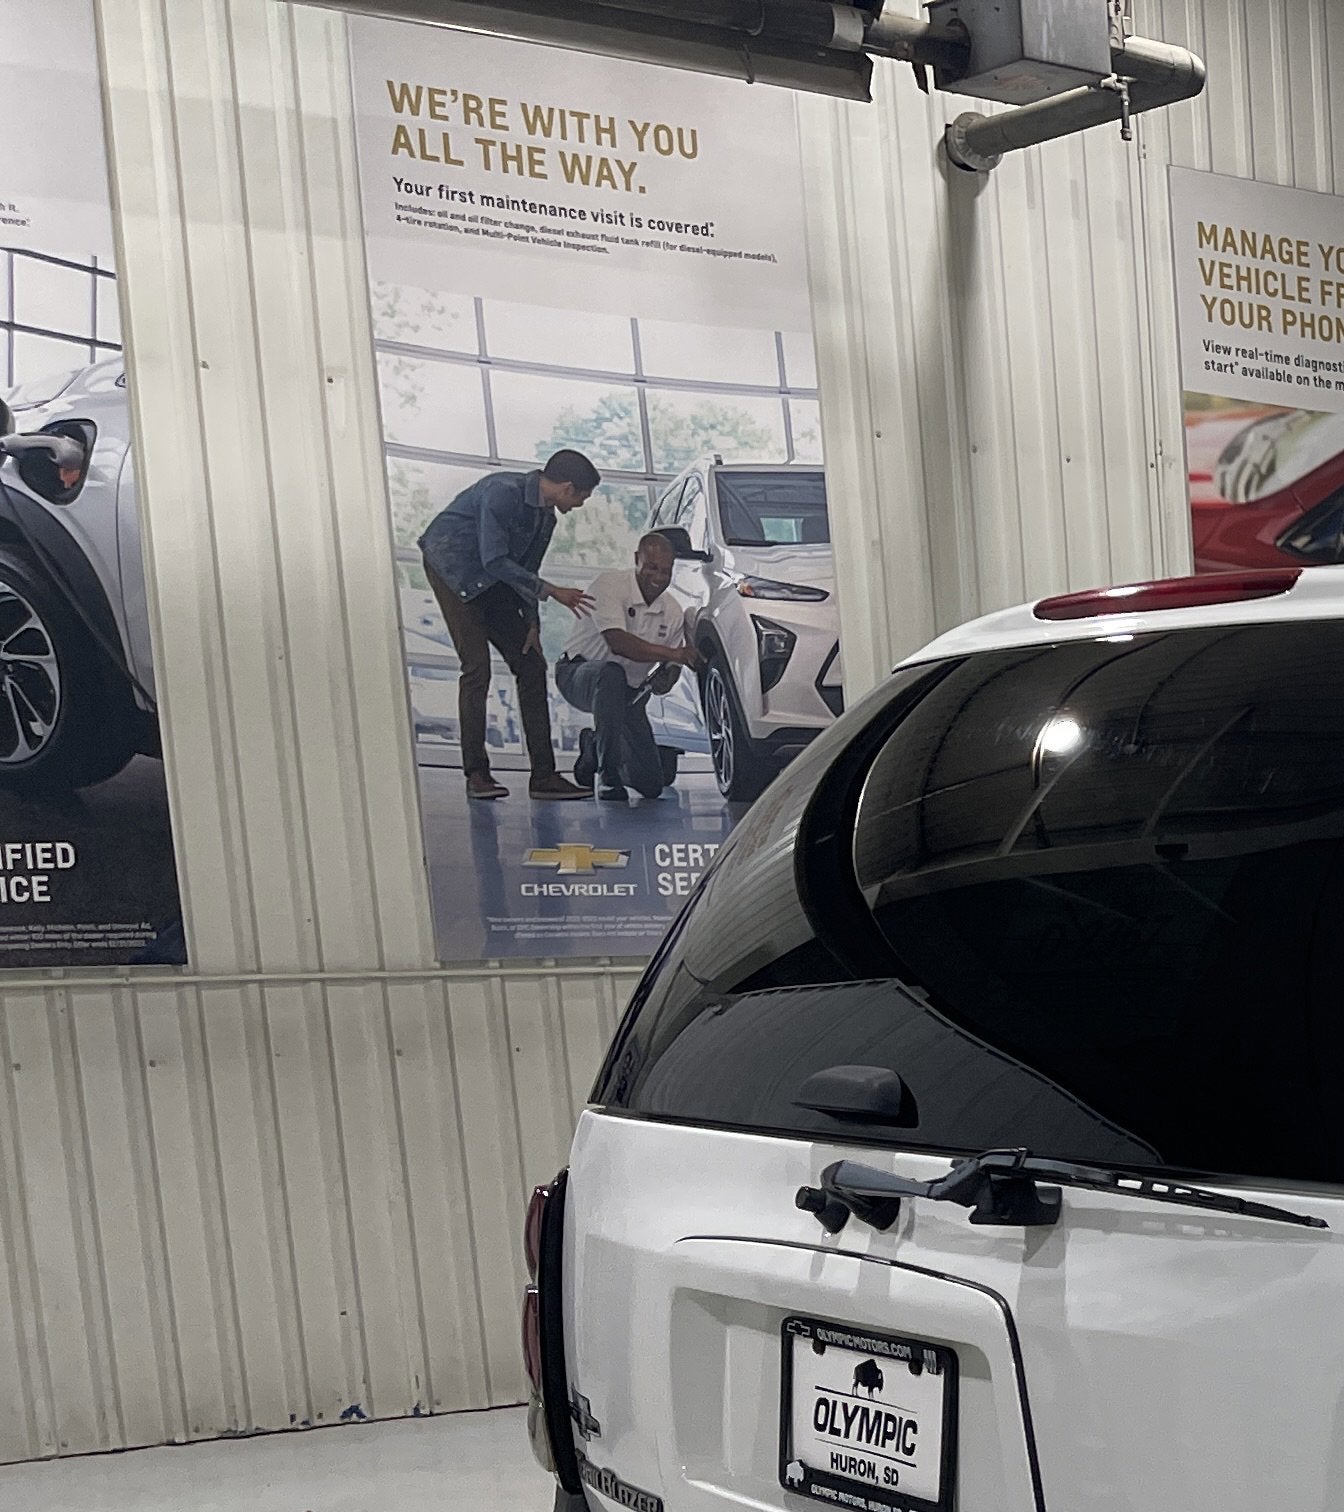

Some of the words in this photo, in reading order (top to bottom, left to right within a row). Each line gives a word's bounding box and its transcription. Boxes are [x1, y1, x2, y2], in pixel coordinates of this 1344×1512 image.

[386, 79, 508, 131] WE'RE
[520, 102, 618, 148] WITH
[628, 119, 698, 160] YOU
[391, 124, 464, 167] ALL
[474, 137, 549, 180] THE
[558, 150, 647, 194] WAY.
[393, 176, 432, 197] Your
[437, 184, 475, 204] first
[480, 194, 587, 222] maintenance
[590, 208, 626, 227] visit
[629, 212, 643, 229] is
[1197, 221, 1310, 268] MANAGE
[1198, 258, 1312, 304] VEHICLE
[1200, 294, 1272, 333] YOUR
[1202, 339, 1231, 356] View
[1235, 347, 1290, 366] real-time
[1241, 366, 1293, 383] available
[1296, 375, 1310, 386] on
[1313, 375, 1332, 389] the
[521, 883, 638, 897] CHEVROLET
[813, 1396, 918, 1457] OLYMPIC
[829, 1451, 880, 1484] HURON,
[883, 1466, 899, 1487] SD
